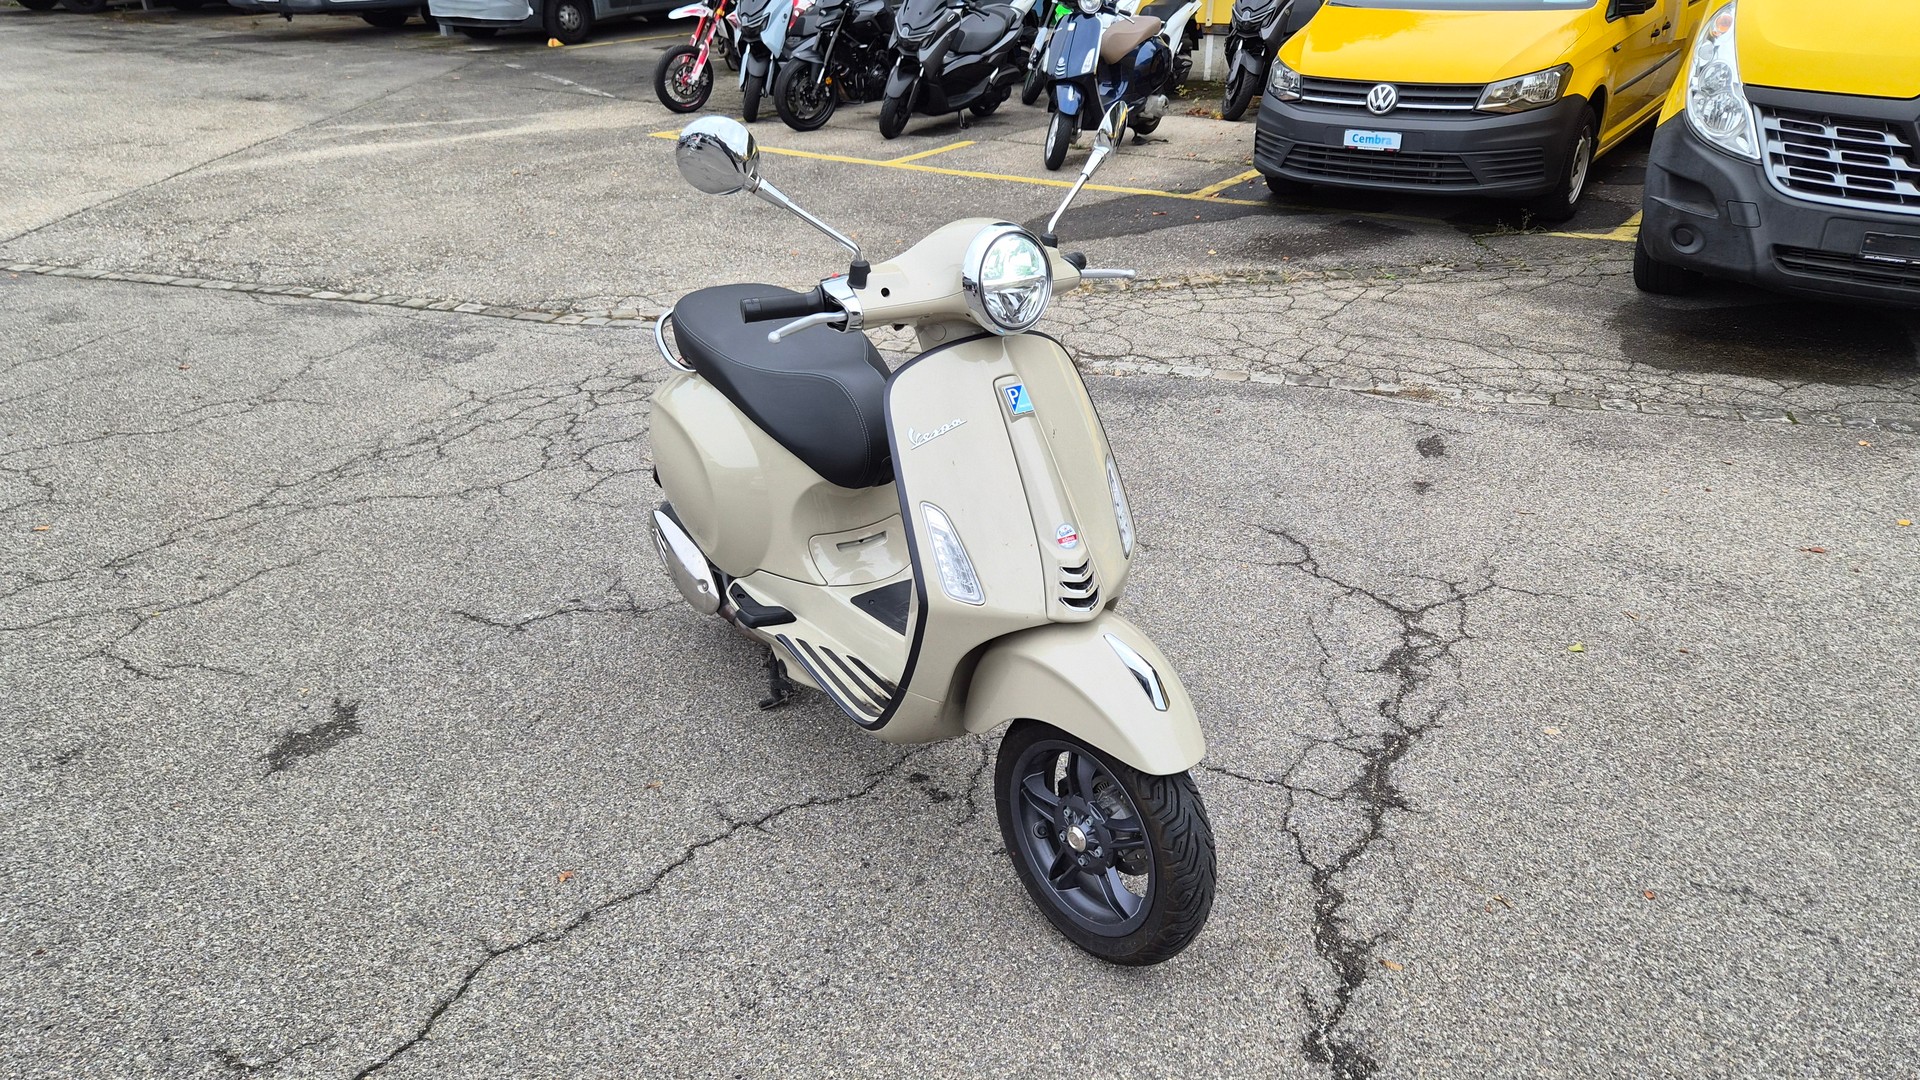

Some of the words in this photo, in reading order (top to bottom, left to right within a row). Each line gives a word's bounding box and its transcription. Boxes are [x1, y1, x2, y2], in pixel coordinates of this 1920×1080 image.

[1352, 133, 1392, 145] Cembra
[1007, 388, 1019, 405] P
[908, 417, 967, 450] Vespa
